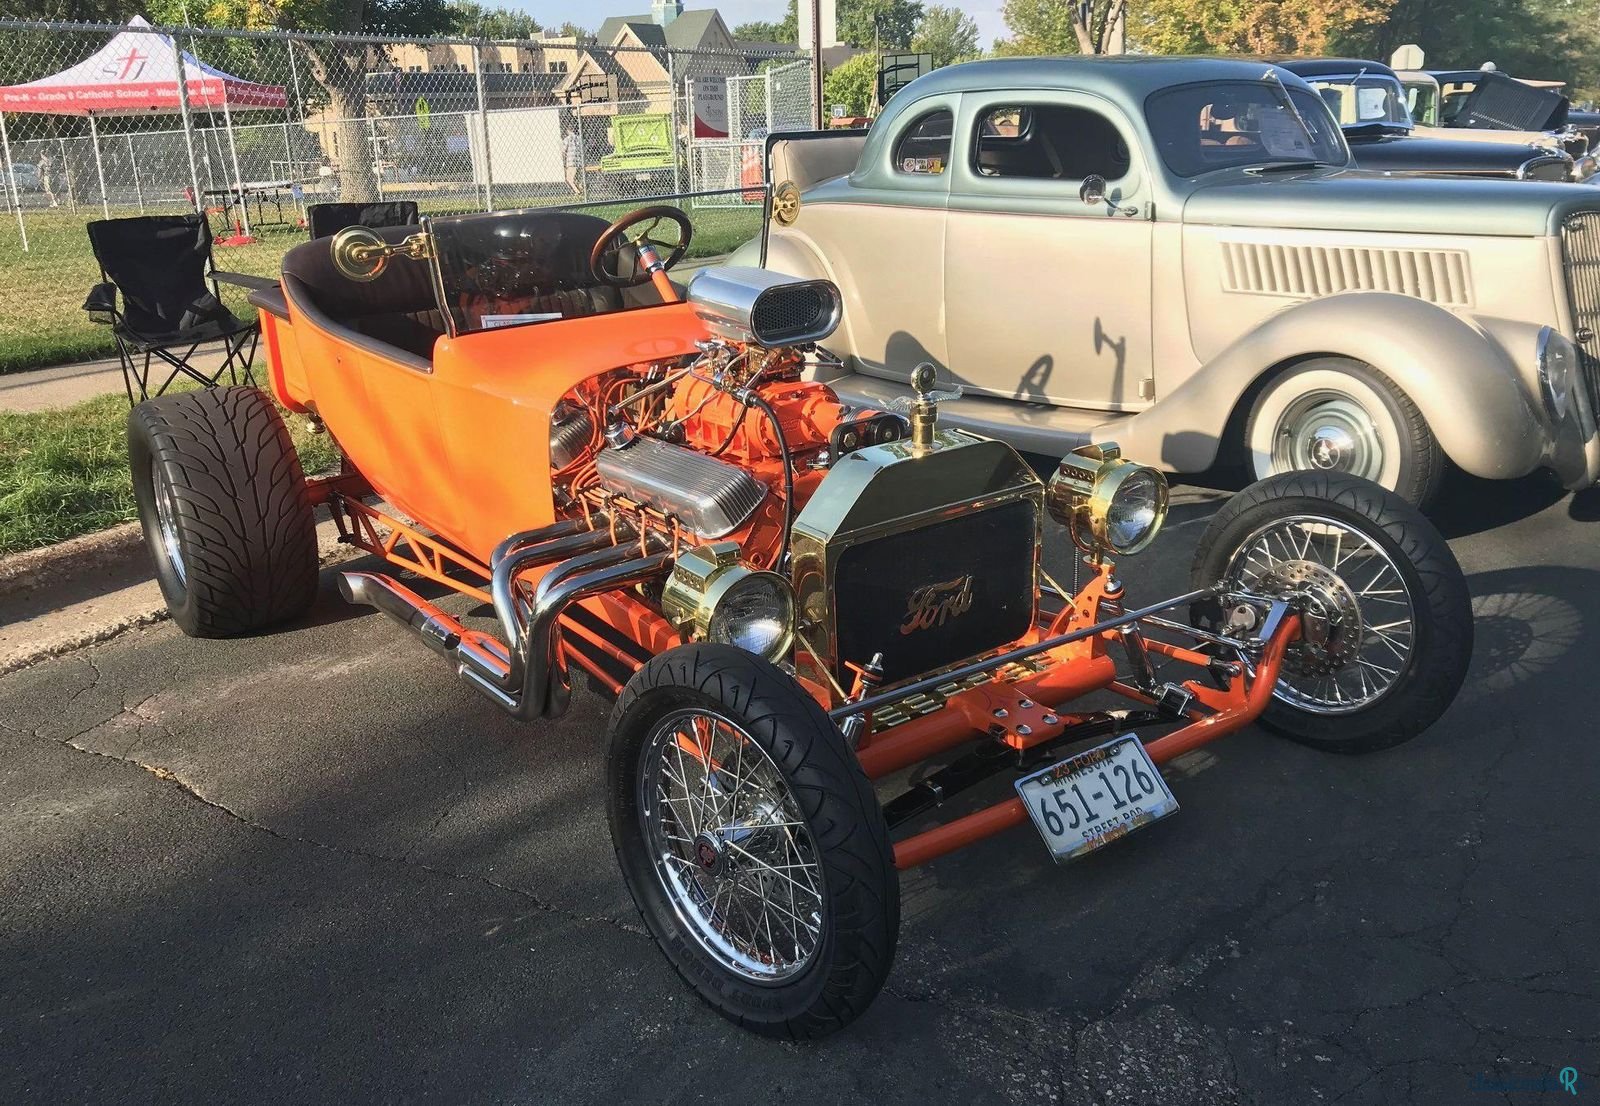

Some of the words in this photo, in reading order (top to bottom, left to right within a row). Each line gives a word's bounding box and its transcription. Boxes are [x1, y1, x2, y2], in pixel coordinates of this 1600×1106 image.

[76, 90, 114, 98] Catholic
[116, 89, 149, 98] School
[900, 574, 973, 635] Ford
[1040, 758, 1155, 837] 651-126
[1081, 816, 1119, 838] STREET
